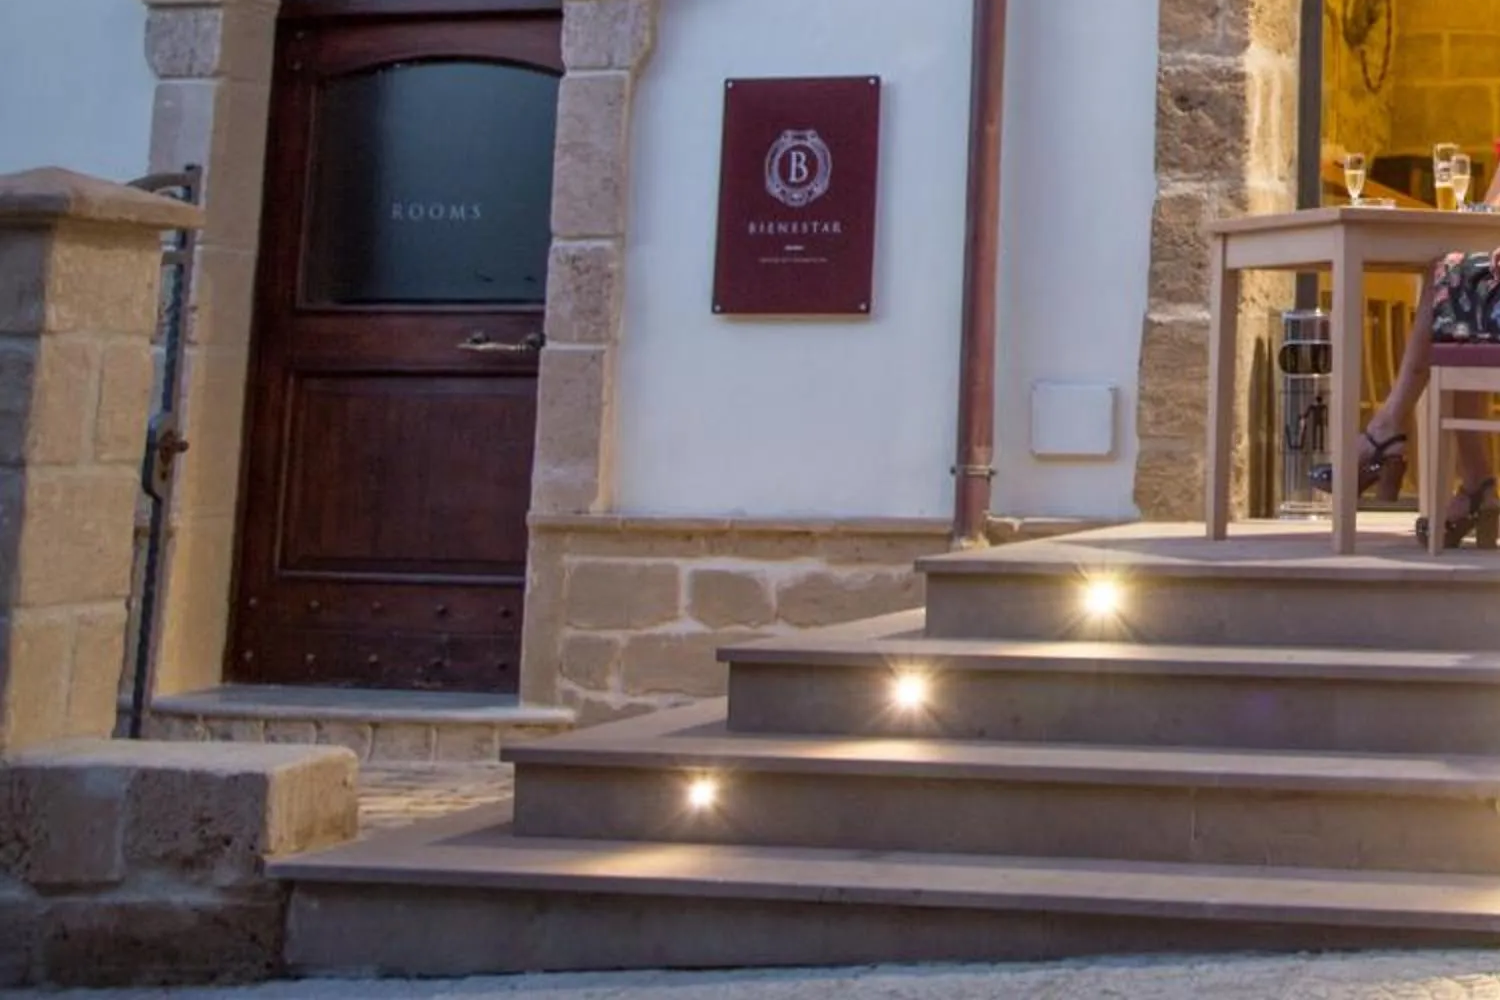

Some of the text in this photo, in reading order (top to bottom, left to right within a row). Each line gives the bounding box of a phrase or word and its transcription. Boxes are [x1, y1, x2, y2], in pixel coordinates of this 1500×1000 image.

[789, 151, 808, 183] B
[391, 202, 481, 220] ROOMS
[748, 220, 842, 235] BIENESTAR
